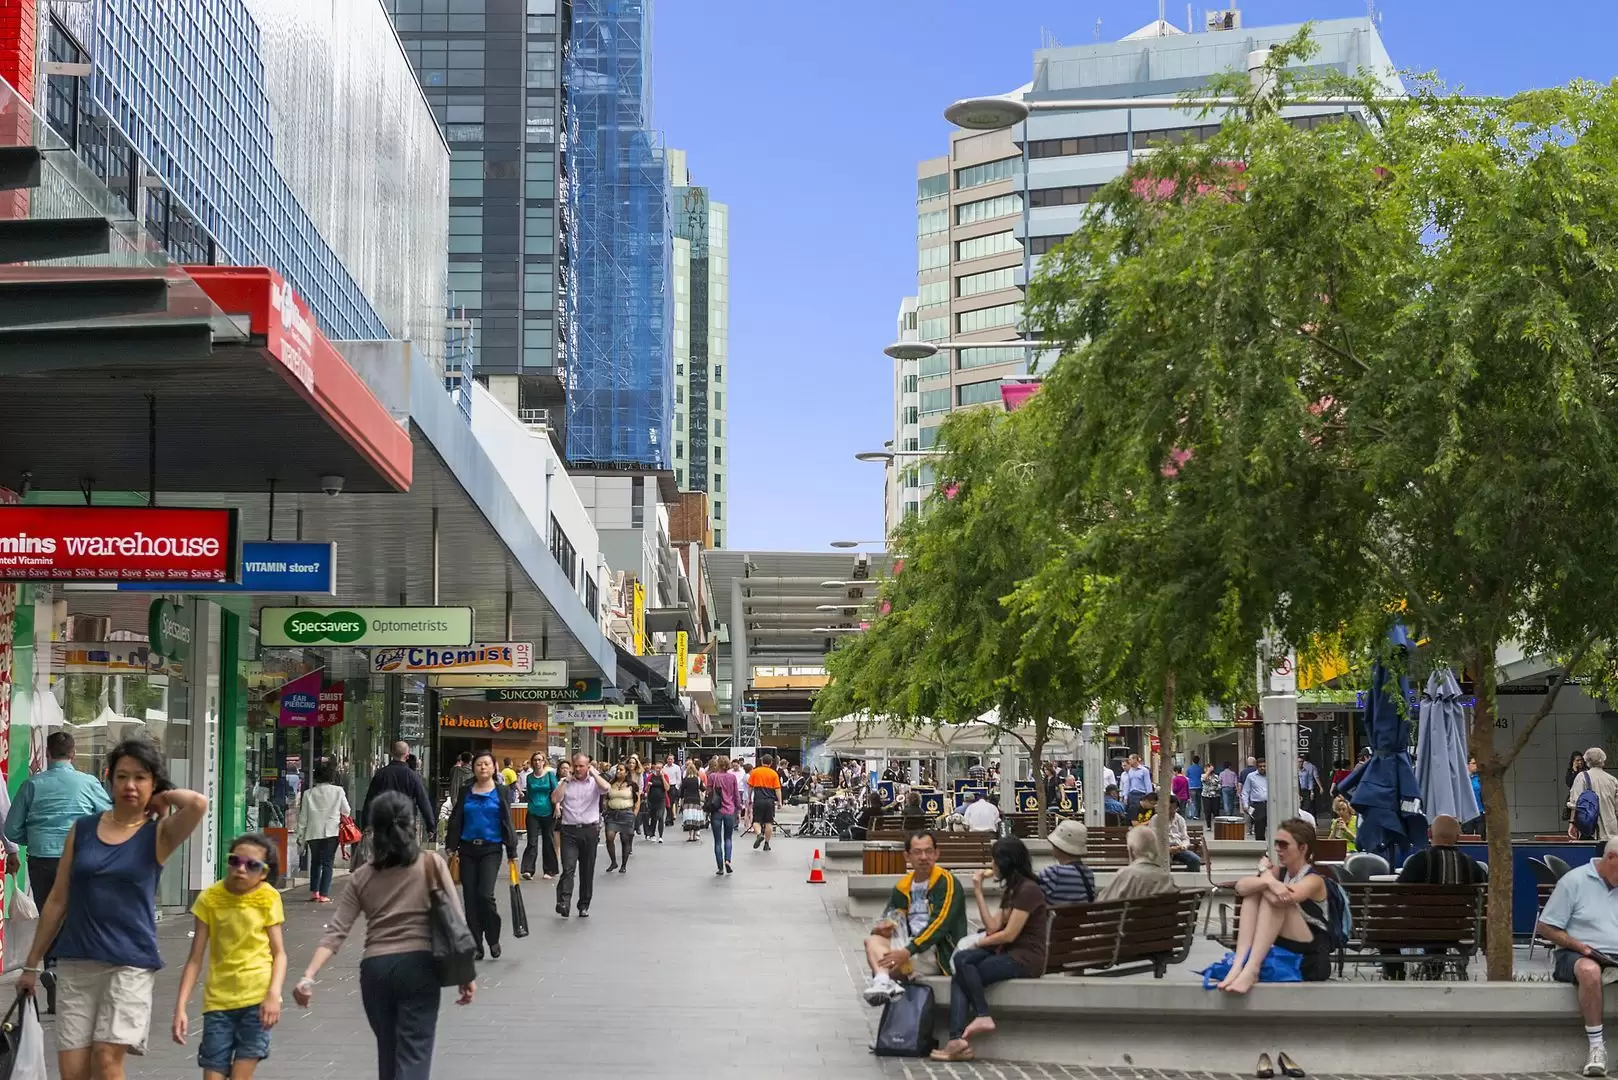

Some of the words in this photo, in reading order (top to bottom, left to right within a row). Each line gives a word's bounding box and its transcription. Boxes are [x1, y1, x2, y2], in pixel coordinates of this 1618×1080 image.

[0, 533, 56, 553] mins
[63, 532, 219, 556] warehouse
[18, 556, 53, 565] Vitamins
[6, 568, 26, 577] Save
[29, 568, 49, 577] Save
[52, 568, 72, 577] Save
[75, 568, 96, 577] Save
[98, 569, 118, 577] Save
[122, 569, 142, 577] Save
[145, 569, 165, 577] Save
[168, 569, 188, 578] Save
[191, 569, 211, 578] Save
[245, 562, 286, 572] VITAMIN
[289, 563, 320, 573] store?
[291, 620, 360, 634] Specsavers
[372, 620, 448, 634] Optometrists
[408, 645, 511, 667] Chemist
[500, 690, 549, 700] SUNCORP
[550, 690, 580, 699] BANK
[284, 700, 316, 708] PIERCING
[457, 715, 489, 729] Jean's
[505, 717, 544, 731] Coffees
